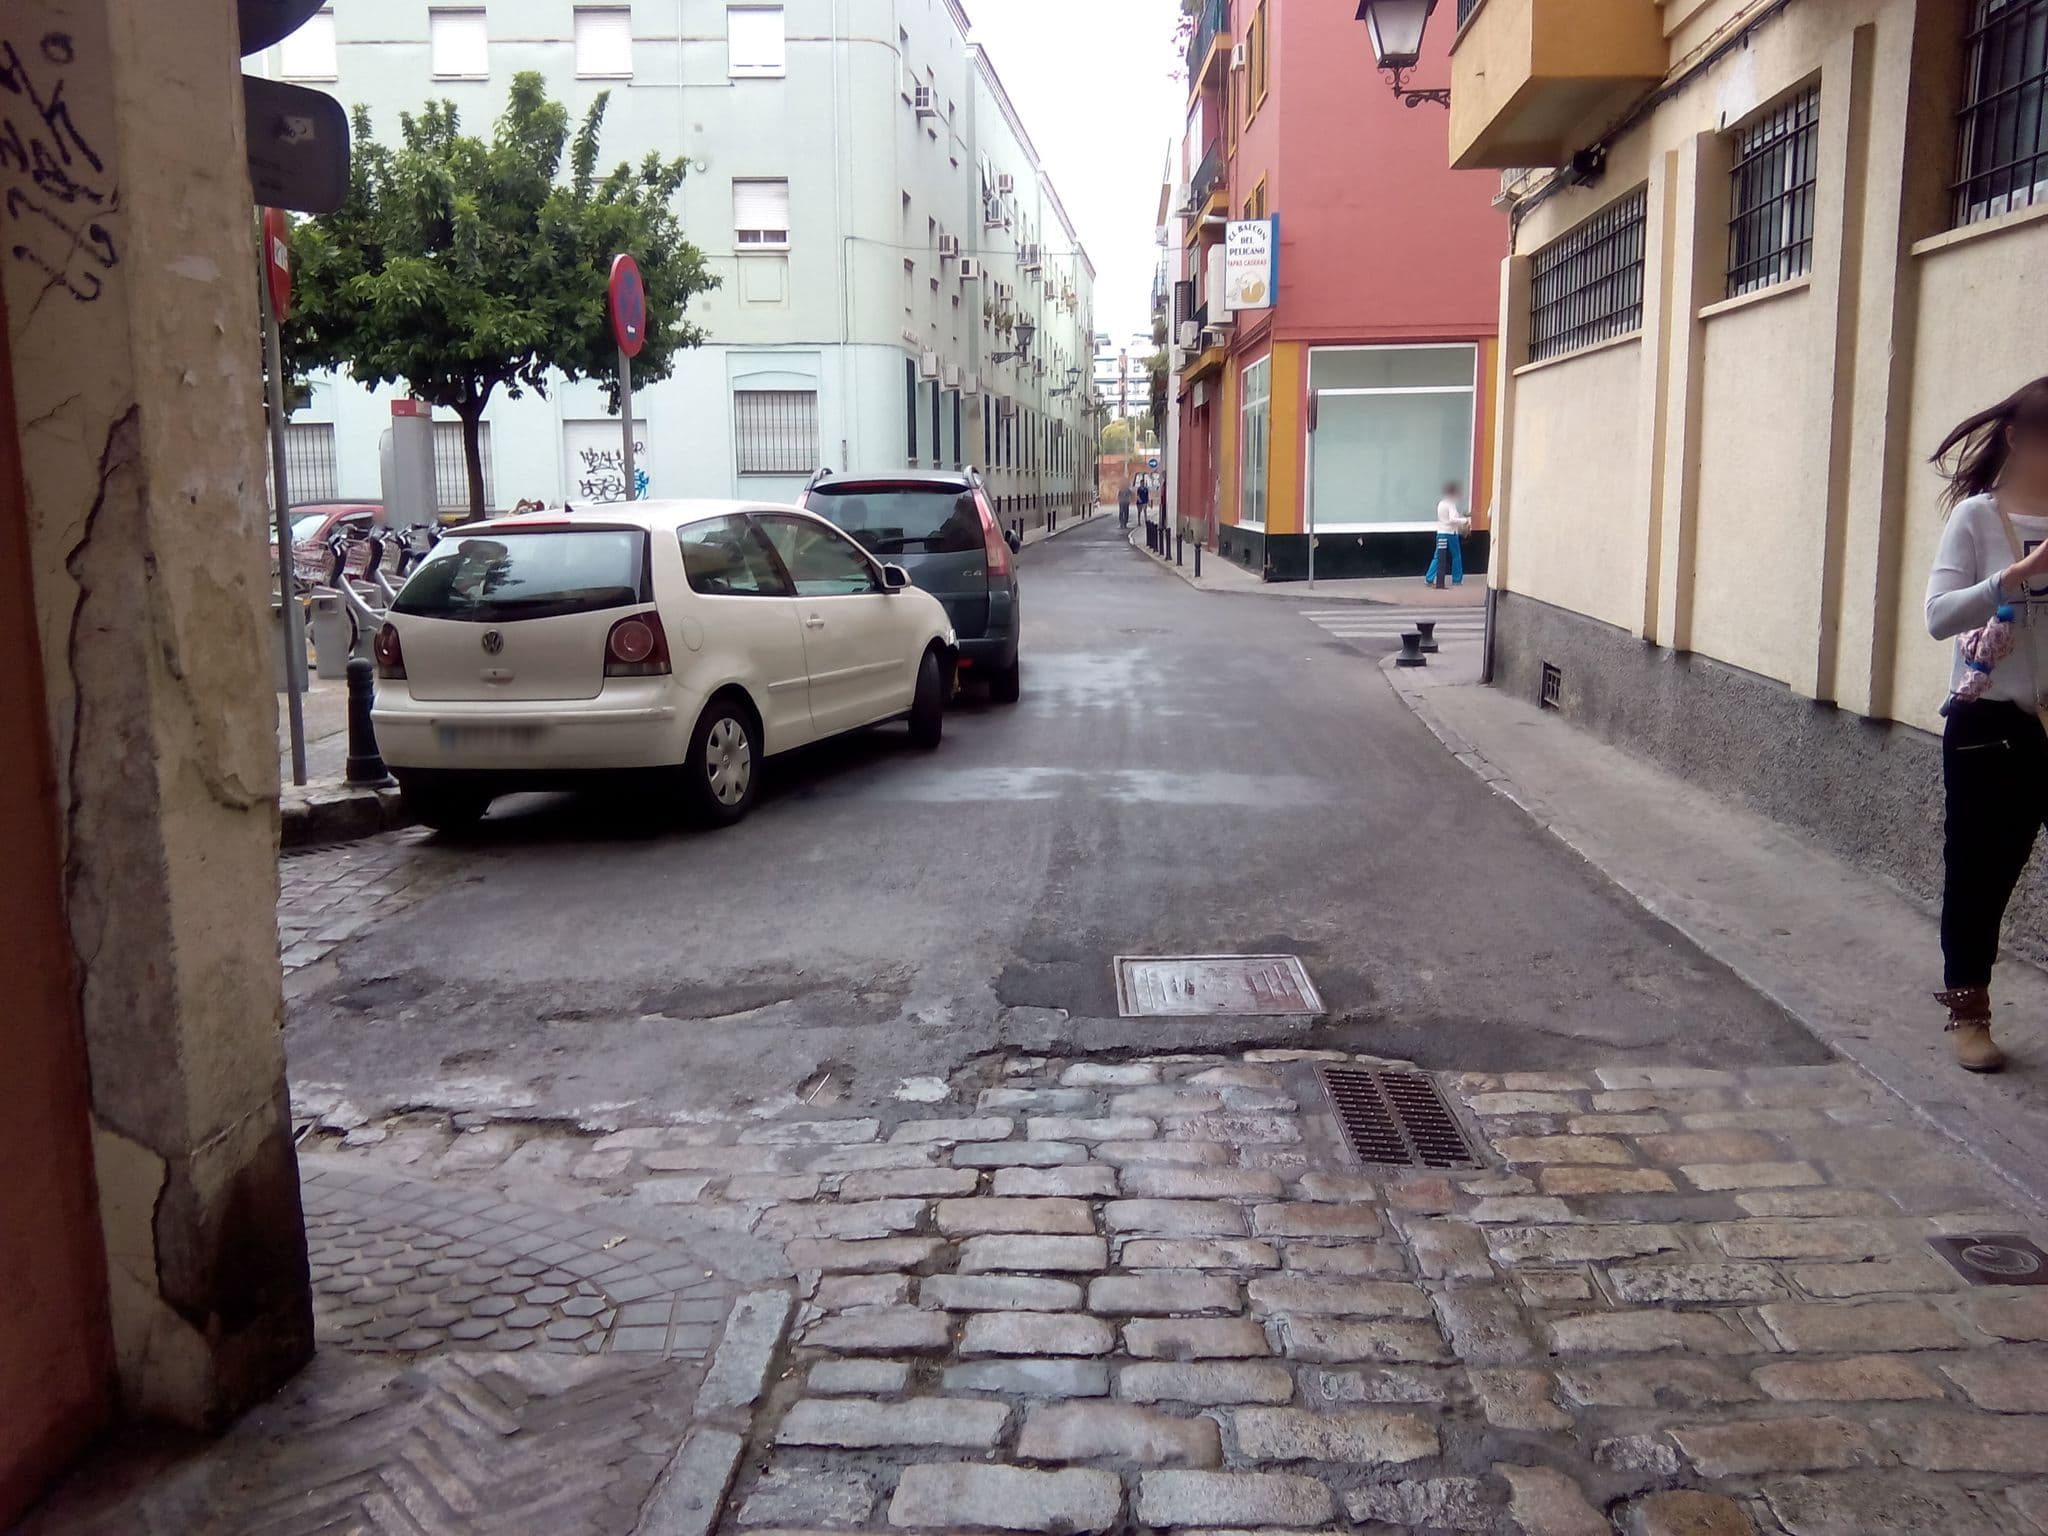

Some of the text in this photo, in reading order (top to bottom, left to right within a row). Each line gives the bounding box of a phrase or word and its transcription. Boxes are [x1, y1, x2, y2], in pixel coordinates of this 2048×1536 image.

[1228, 223, 1267, 242] EL BALCON
[1240, 236, 1253, 244] DEL
[1229, 247, 1265, 256] PELICANO
